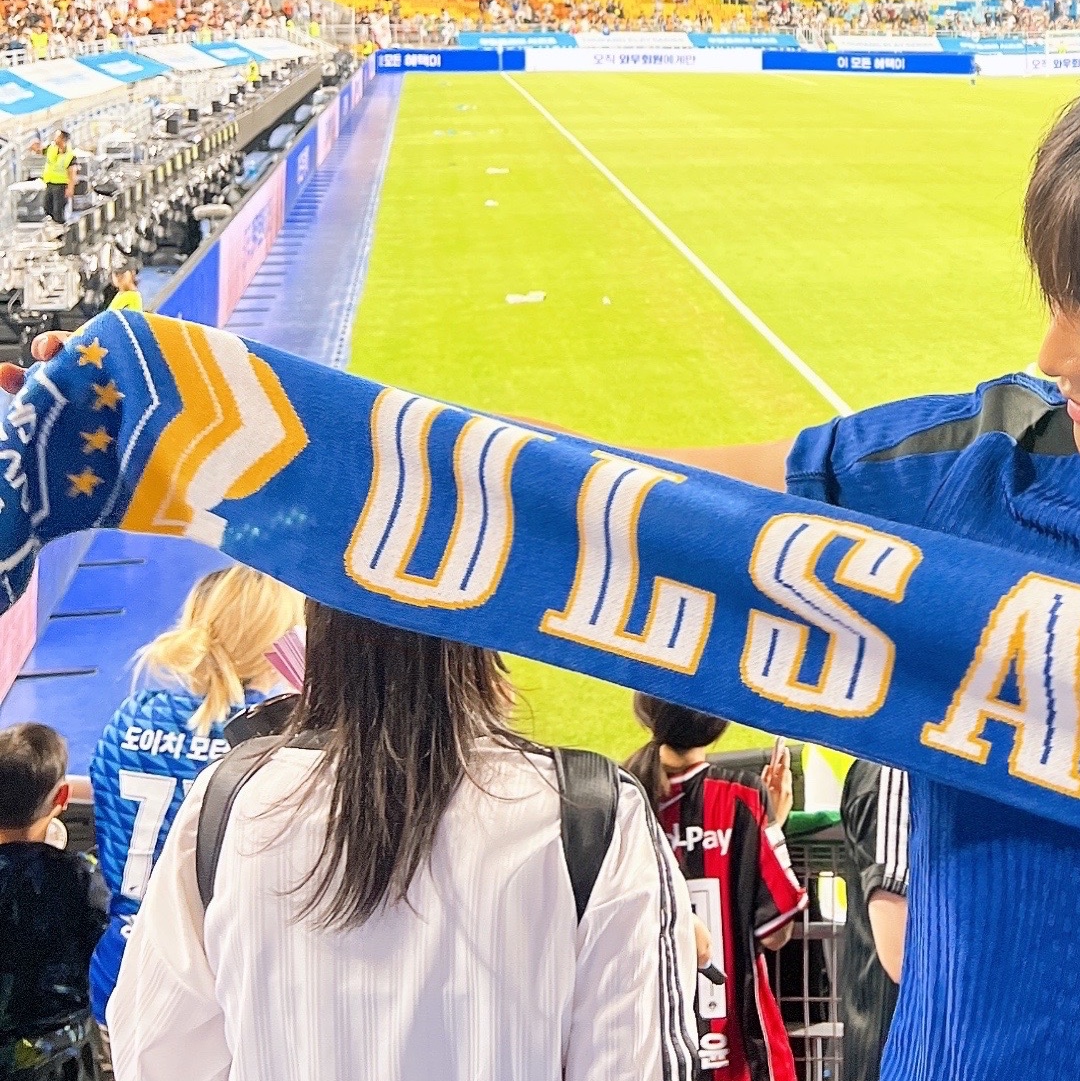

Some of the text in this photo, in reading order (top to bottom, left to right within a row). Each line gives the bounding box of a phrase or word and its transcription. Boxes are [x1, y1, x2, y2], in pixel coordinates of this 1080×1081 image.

[837, 56, 906, 70] 이 모든 혜택이
[120, 725, 187, 760] 도이치
